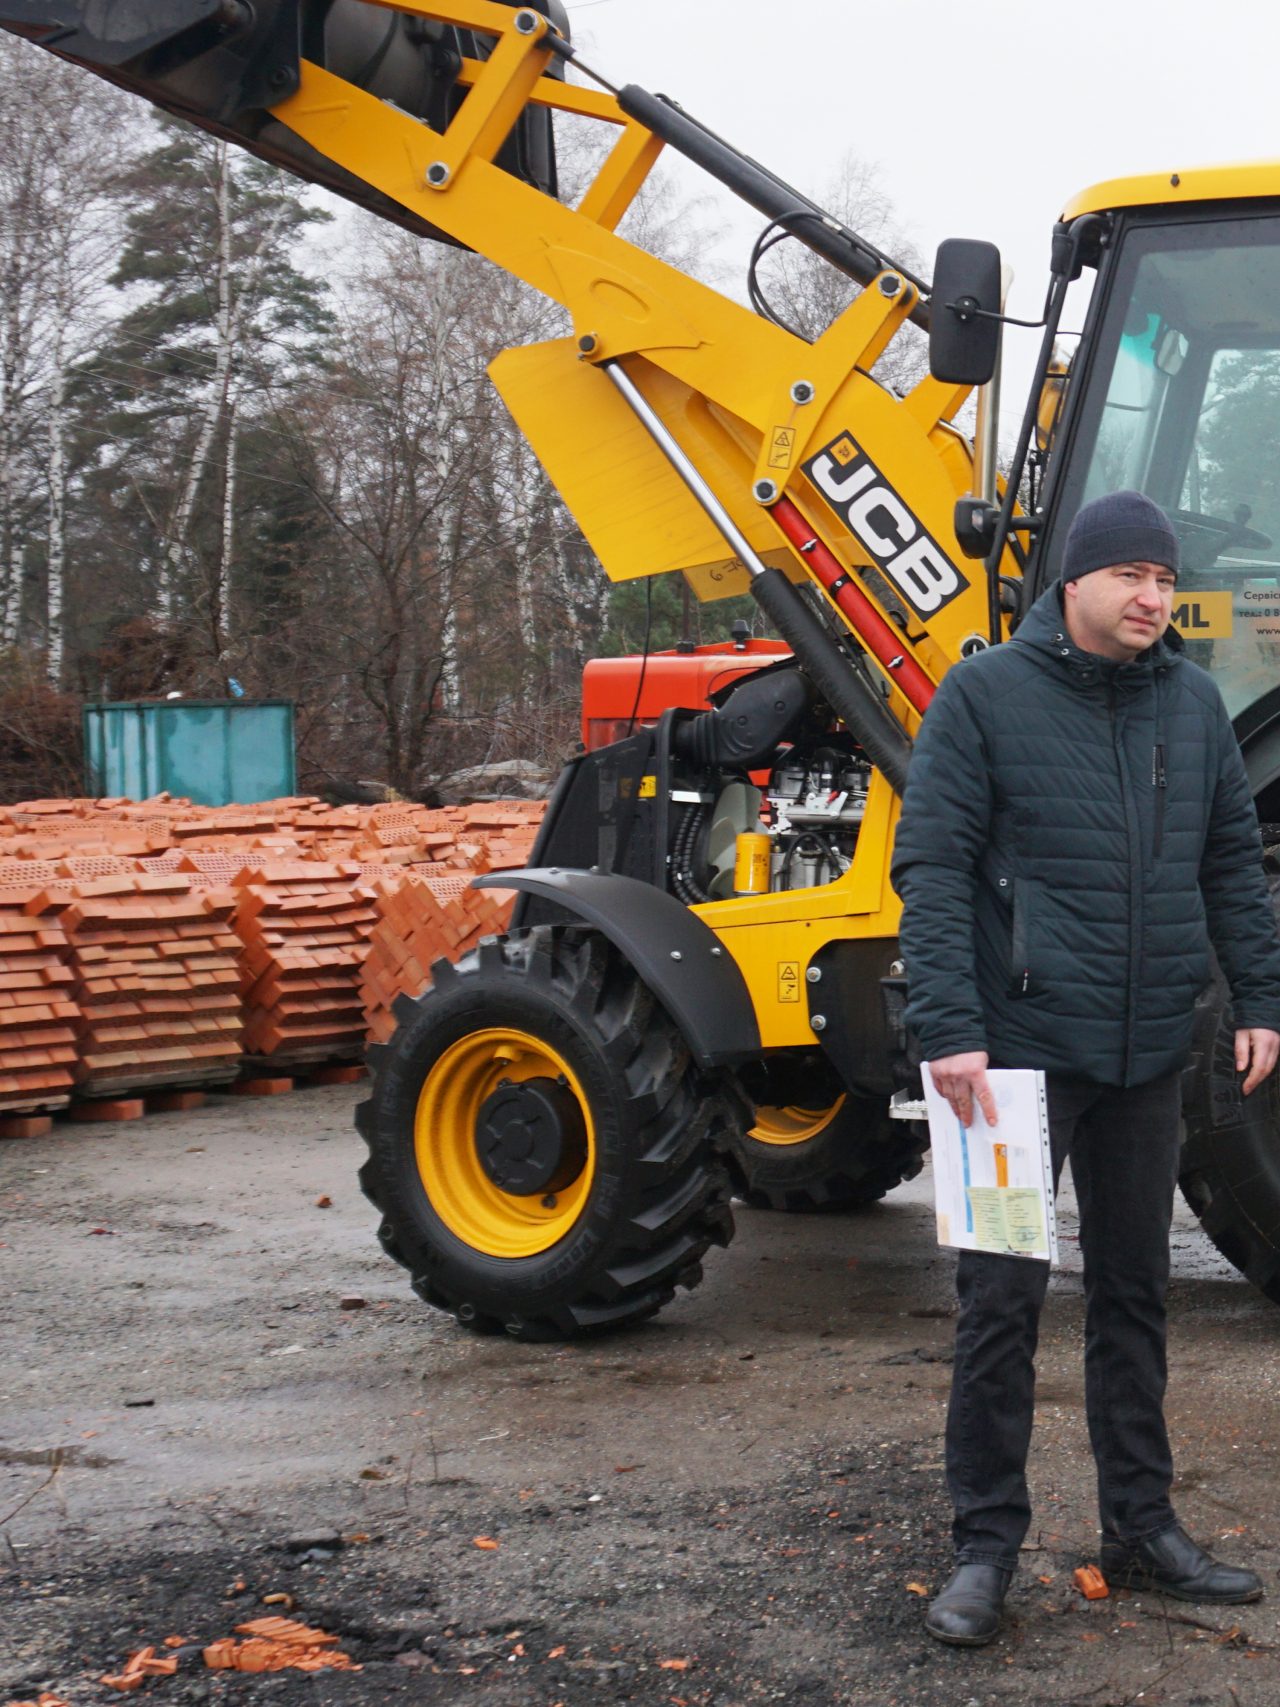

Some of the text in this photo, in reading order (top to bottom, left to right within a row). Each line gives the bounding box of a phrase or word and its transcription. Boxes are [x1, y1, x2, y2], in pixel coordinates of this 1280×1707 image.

[811, 454, 958, 612] JCB
[1171, 603, 1210, 628] ML
[1264, 608, 1271, 617] 0
